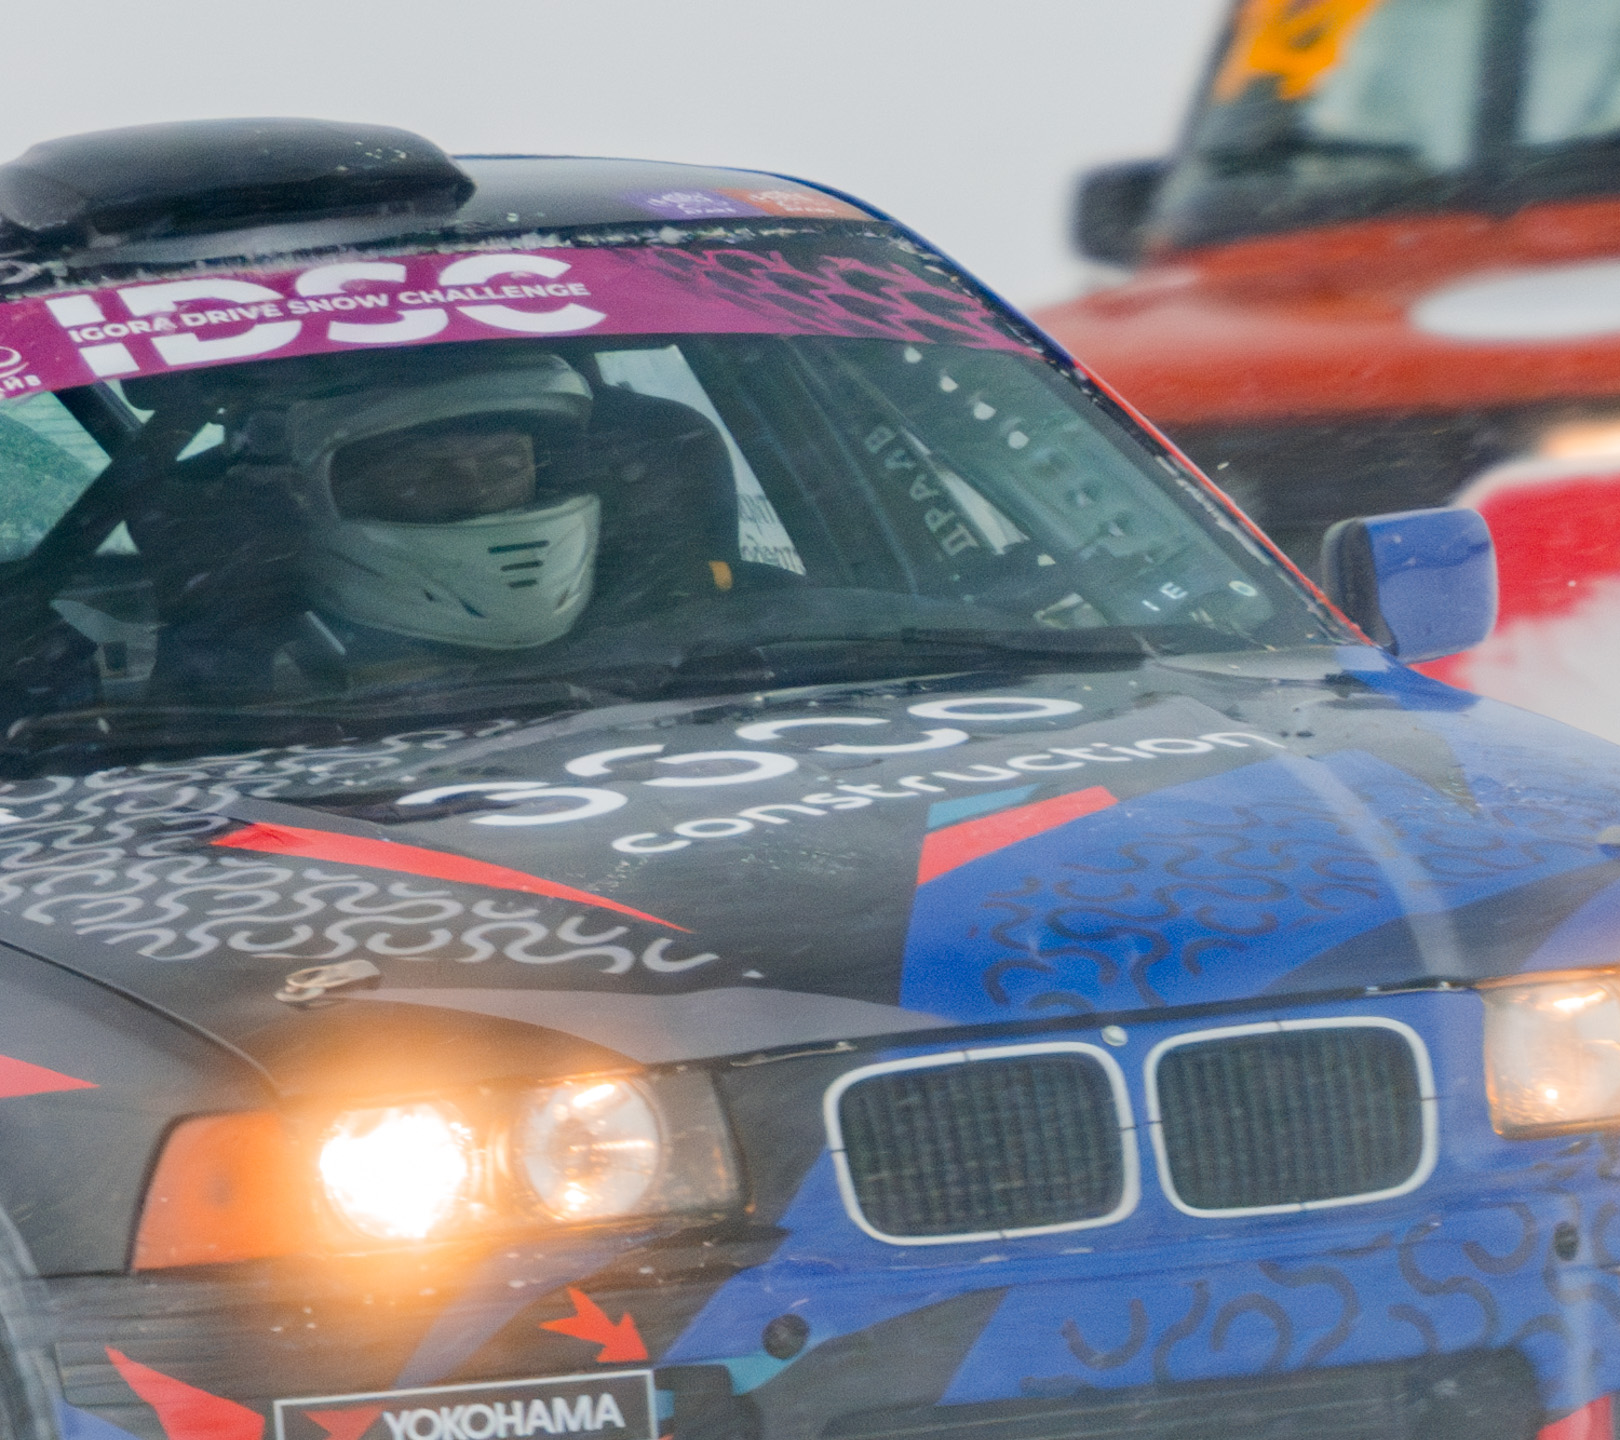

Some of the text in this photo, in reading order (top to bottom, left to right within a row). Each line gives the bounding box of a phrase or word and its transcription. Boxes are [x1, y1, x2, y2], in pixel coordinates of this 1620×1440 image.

[70, 282, 591, 343] IGORA DRIVE SNOW CHALLENGE
[611, 728, 1287, 855] construction
